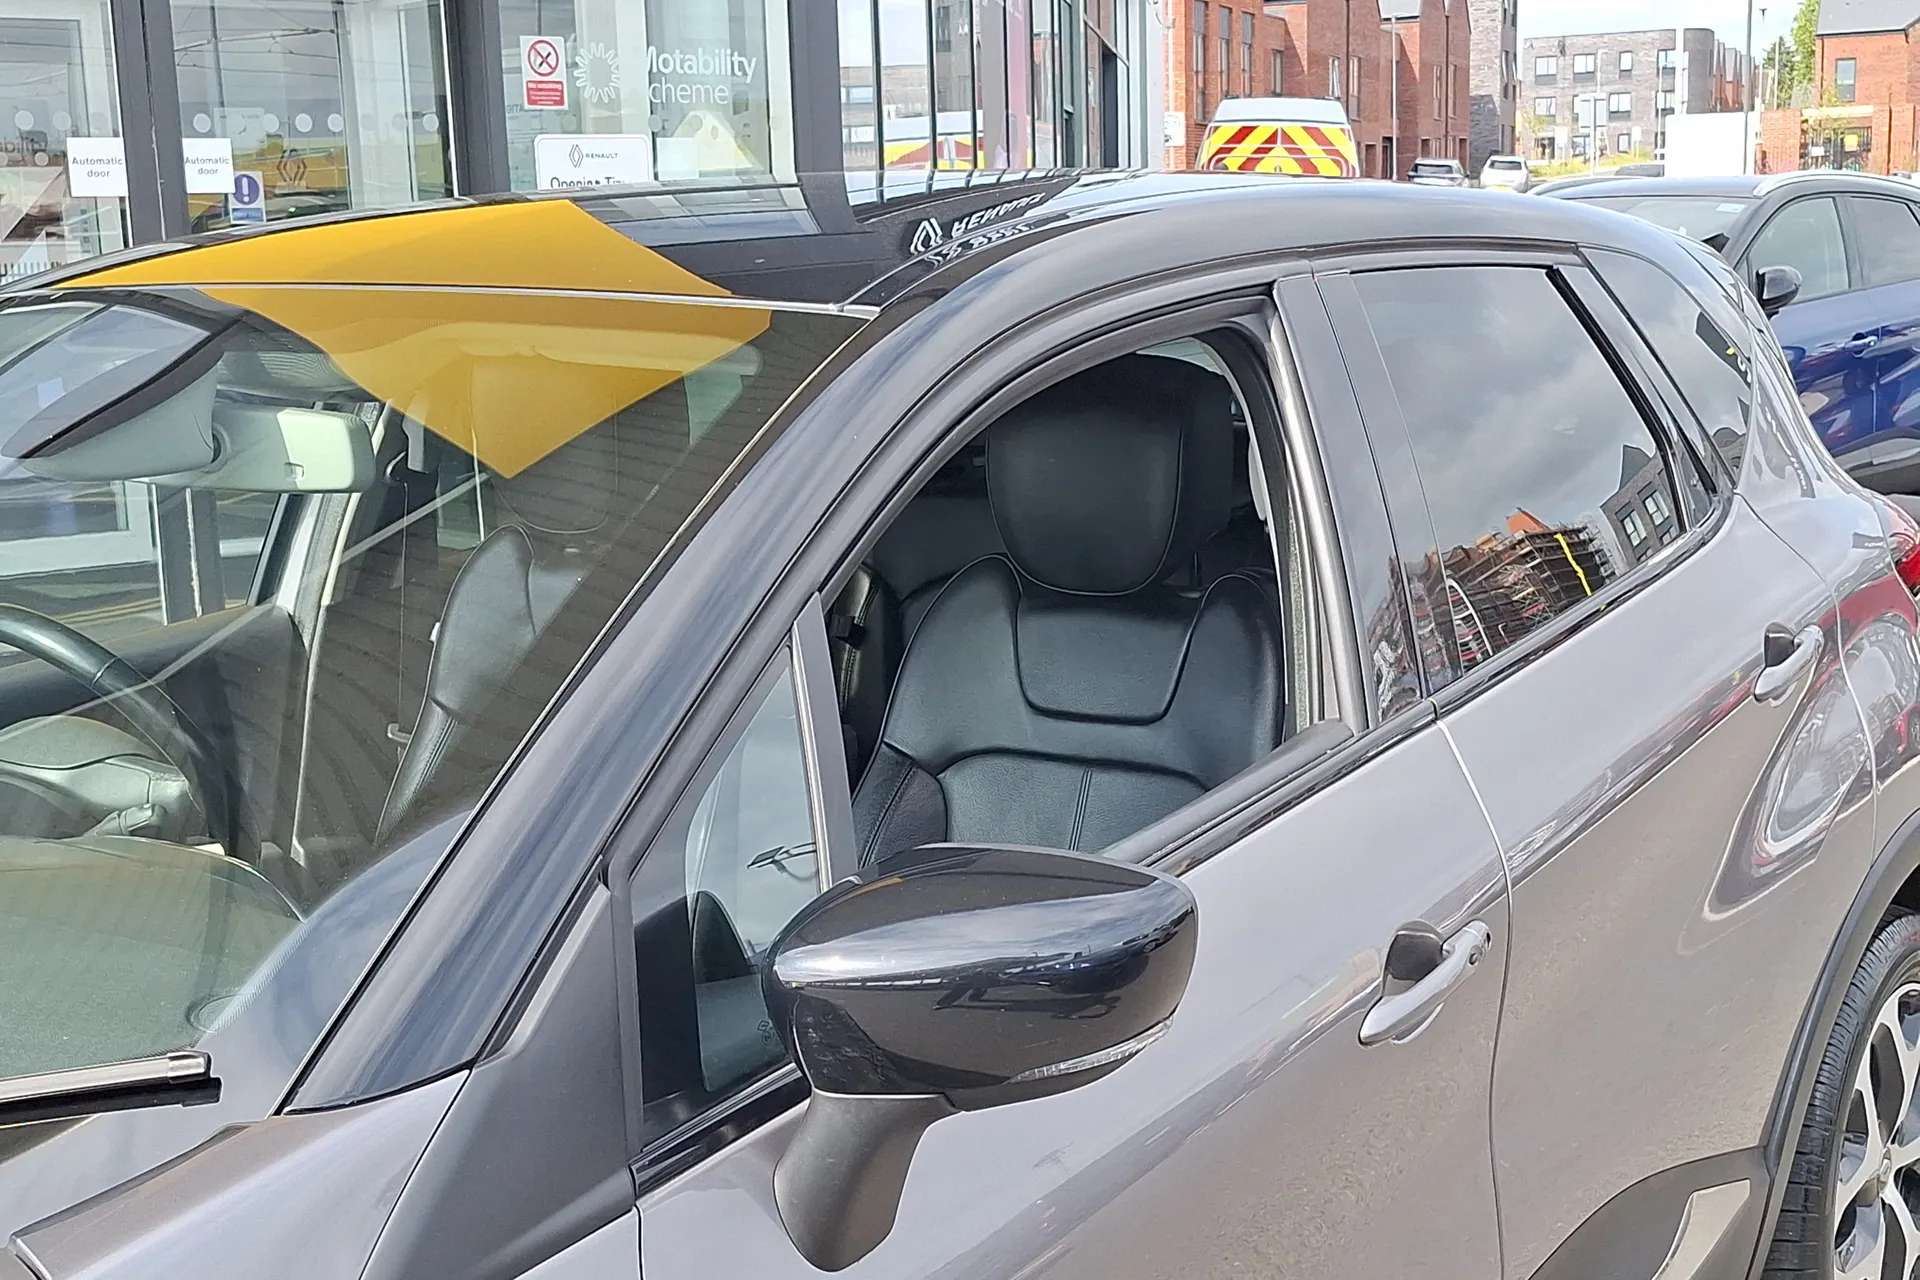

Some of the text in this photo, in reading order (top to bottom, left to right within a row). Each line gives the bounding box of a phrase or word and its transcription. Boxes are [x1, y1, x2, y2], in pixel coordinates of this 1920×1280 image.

[649, 76, 729, 104] cheme
[71, 156, 123, 166] Automatic
[185, 156, 230, 165] Automatic
[86, 169, 111, 178] door
[197, 167, 219, 175] door
[550, 177, 600, 188] Oenin
